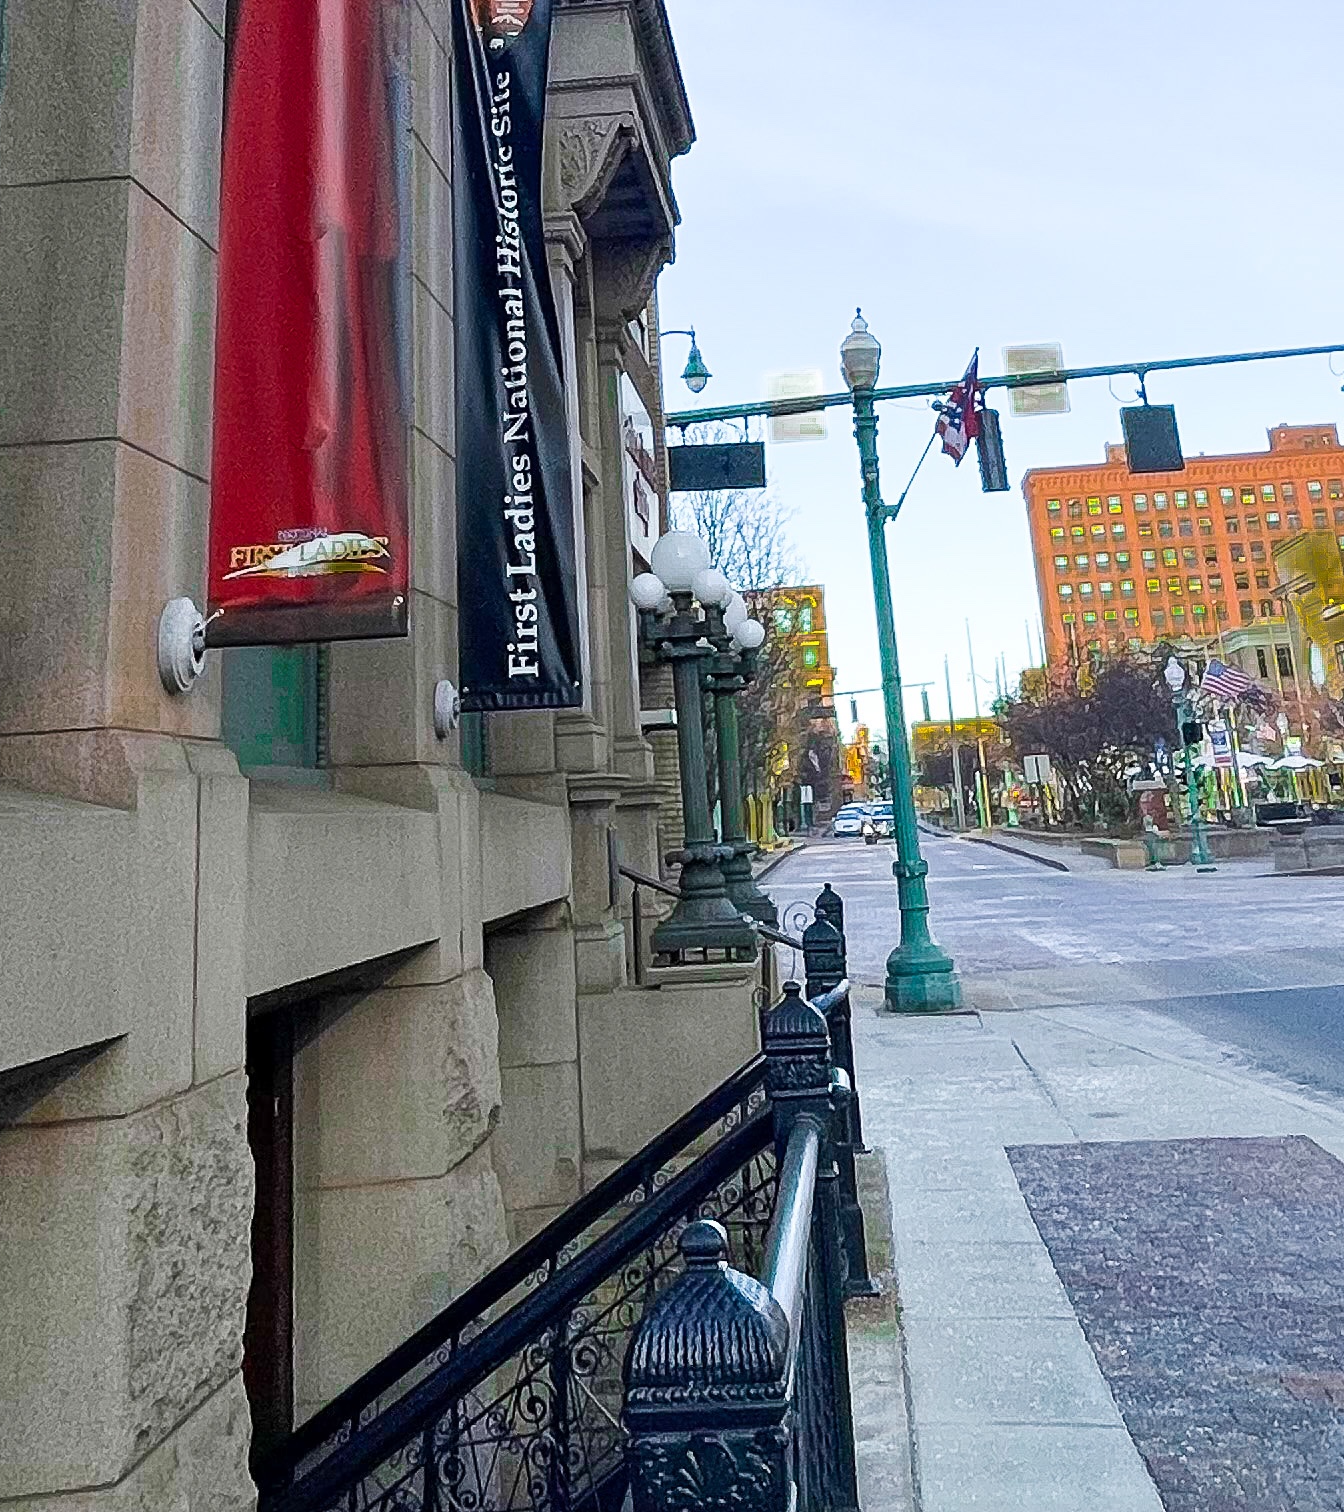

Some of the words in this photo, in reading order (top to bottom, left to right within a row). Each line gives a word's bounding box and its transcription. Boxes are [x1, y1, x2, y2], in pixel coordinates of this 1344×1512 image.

[490, 71, 511, 138] Site
[493, 145, 523, 279] Historic
[498, 287, 530, 445] National
[502, 454, 537, 579] Ladies
[507, 586, 540, 680] First
